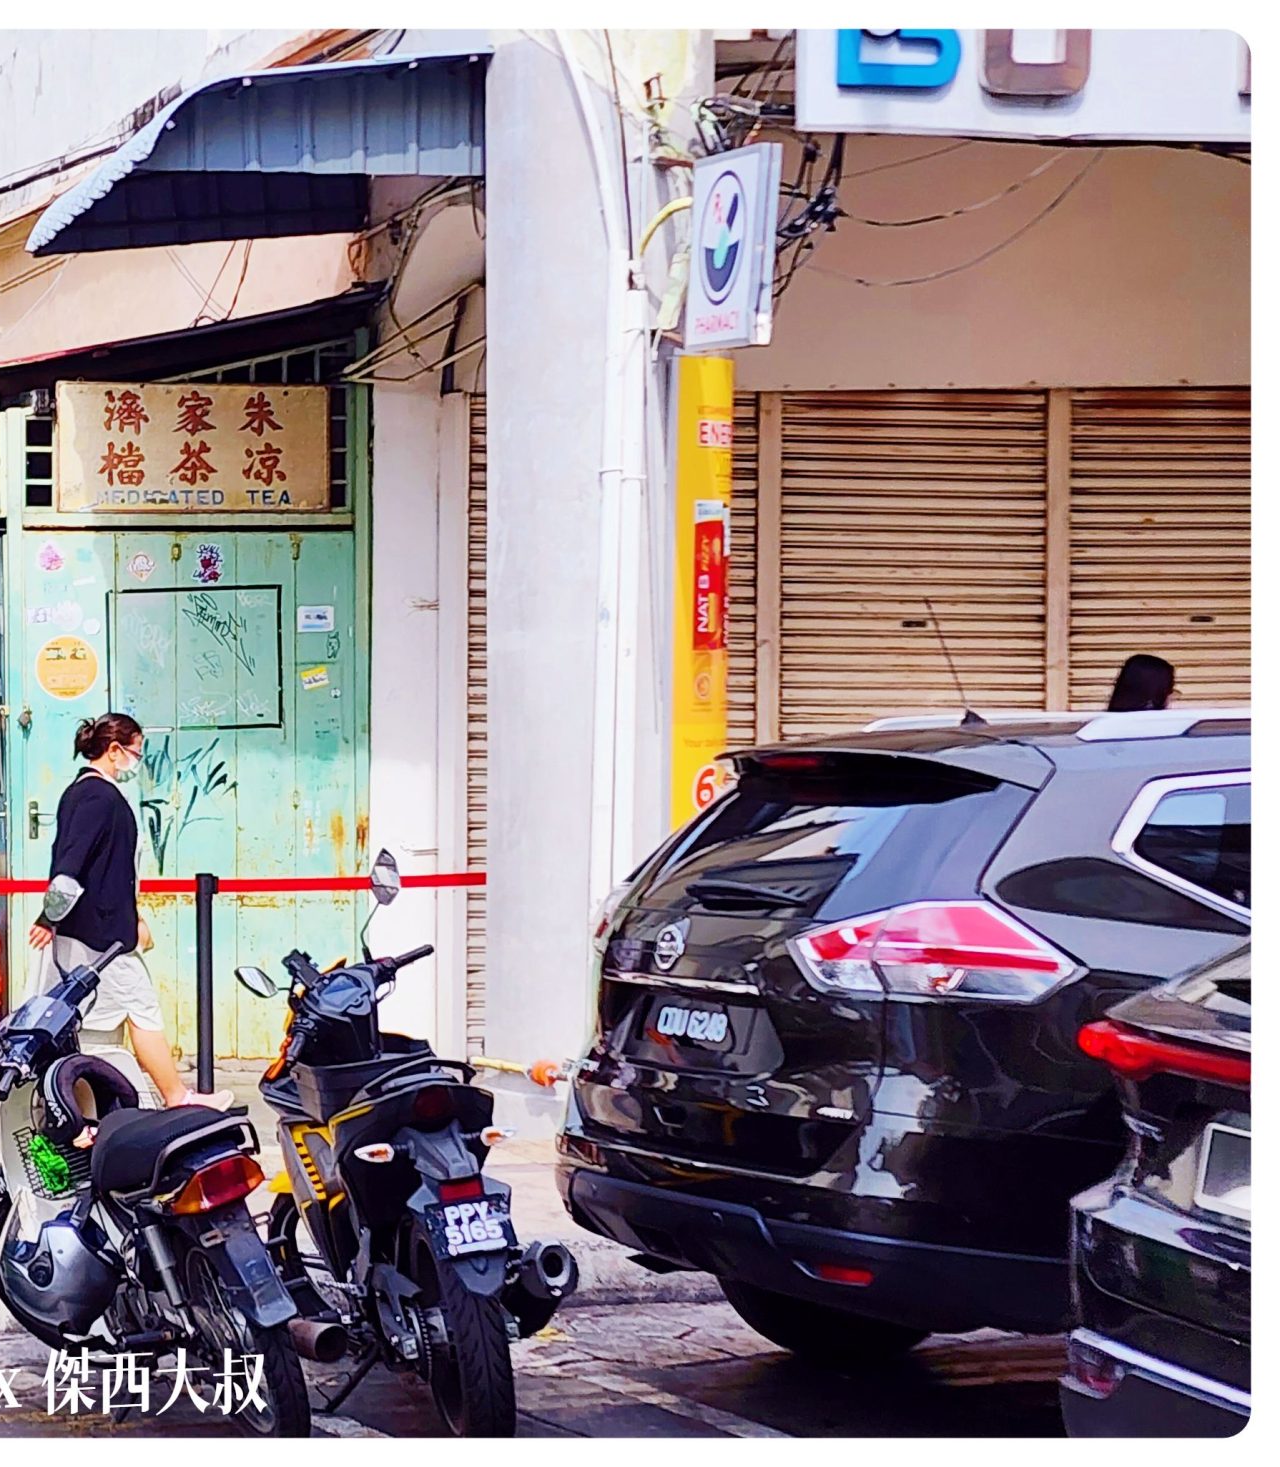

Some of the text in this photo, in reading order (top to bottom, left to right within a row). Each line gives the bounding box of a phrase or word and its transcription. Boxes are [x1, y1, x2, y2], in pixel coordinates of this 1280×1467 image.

[246, 489, 292, 505] TEA
[444, 1200, 489, 1226] PPY
[444, 1219, 503, 1245] 5165
